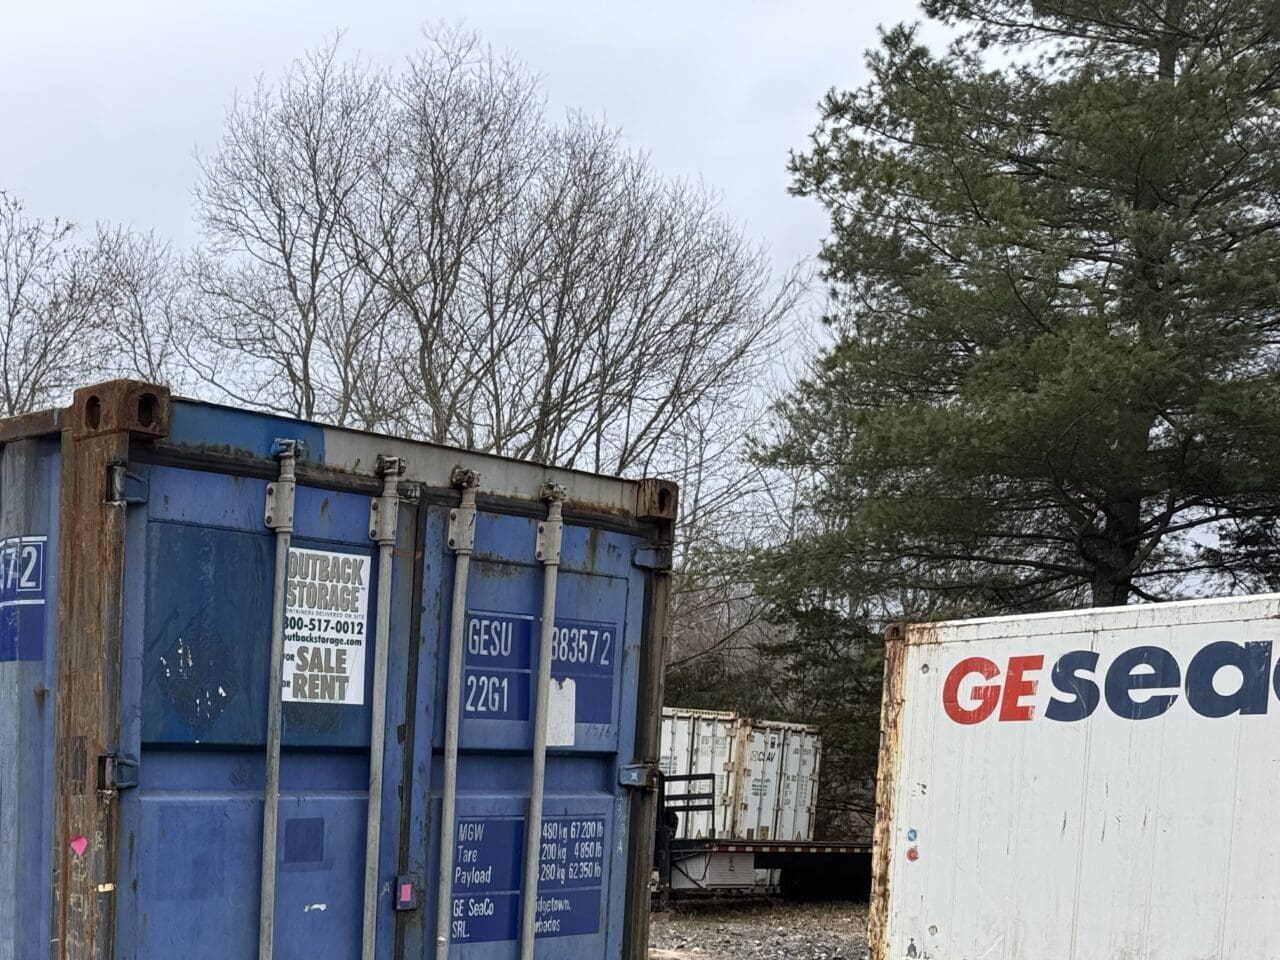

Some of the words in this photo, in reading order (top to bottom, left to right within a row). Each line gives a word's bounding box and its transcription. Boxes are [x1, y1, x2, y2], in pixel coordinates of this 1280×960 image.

[289, 552, 364, 585] OUTBACK
[287, 580, 359, 613] STORAGE
[468, 618, 513, 656] GESU
[296, 646, 347, 674] SALE
[292, 673, 349, 701] RENT
[466, 675, 508, 712] 22G1
[942, 640, 1280, 725] GEsea
[459, 823, 485, 841] MGW
[458, 845, 478, 862] Tare
[455, 865, 492, 888] Payload
[453, 899, 465, 917] GE
[468, 898, 494, 917] SeaCo
